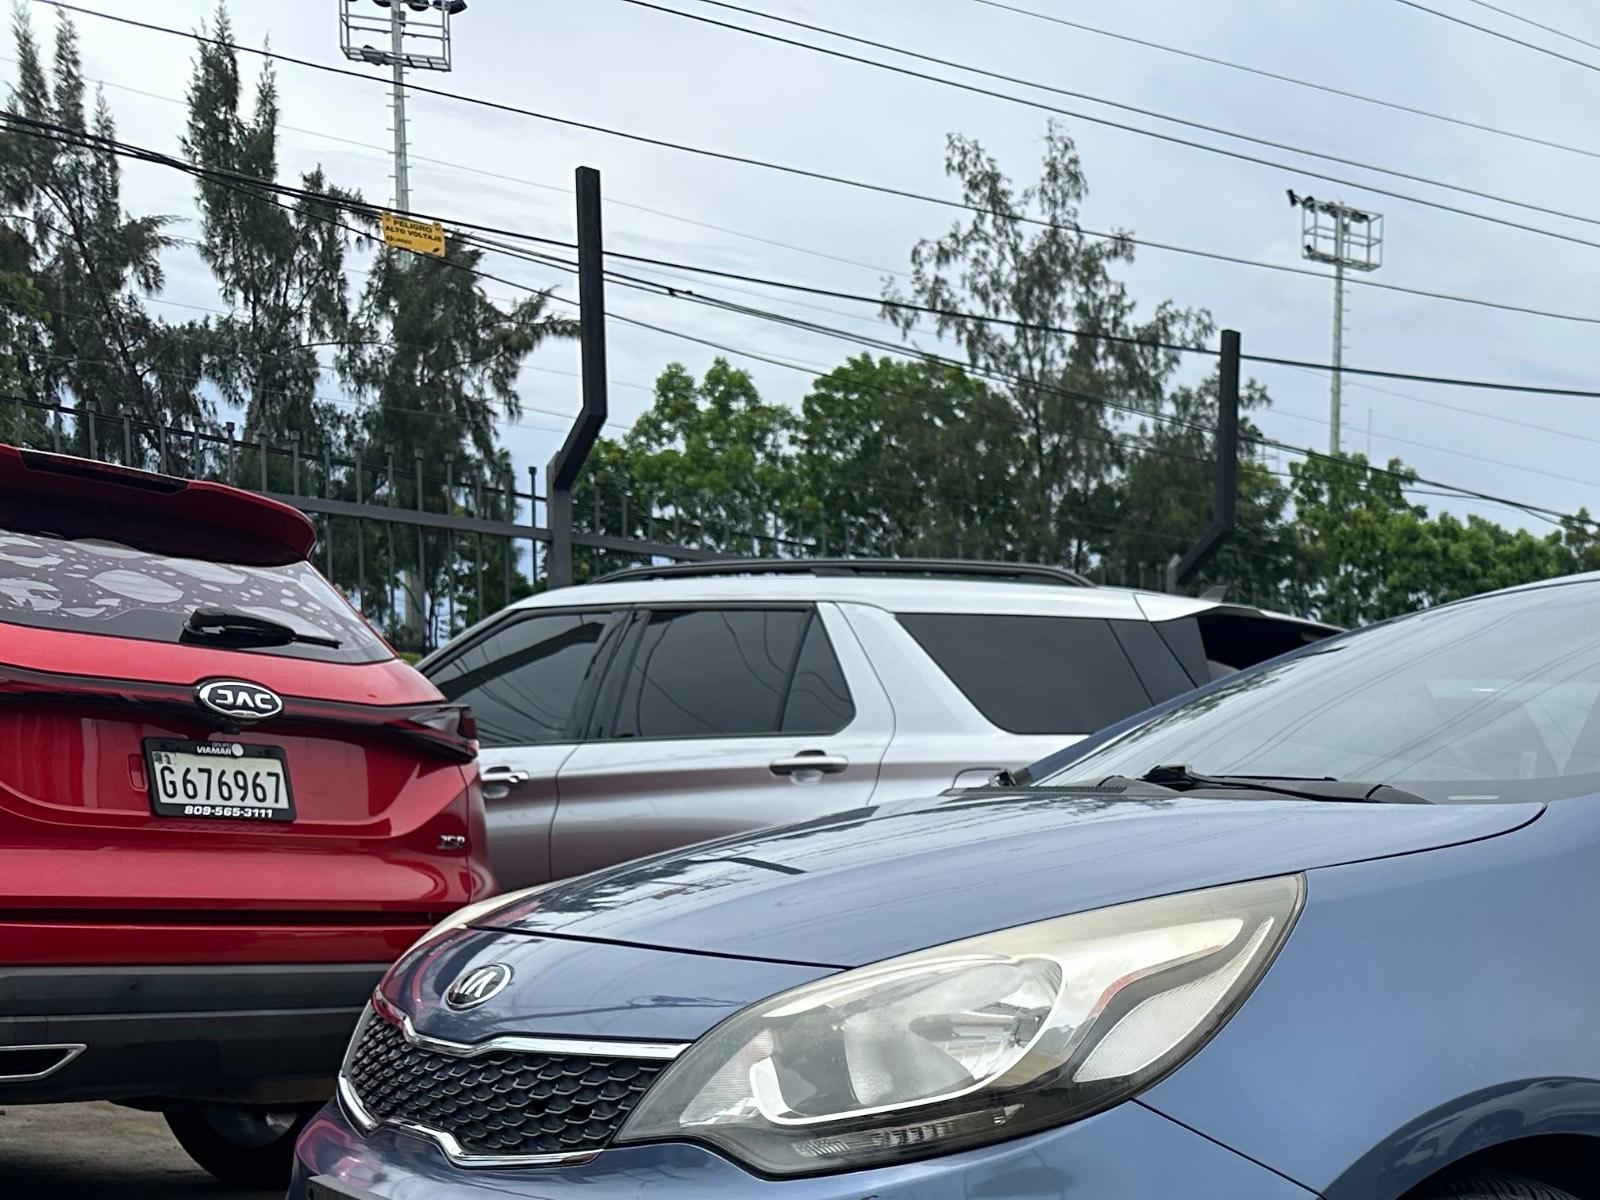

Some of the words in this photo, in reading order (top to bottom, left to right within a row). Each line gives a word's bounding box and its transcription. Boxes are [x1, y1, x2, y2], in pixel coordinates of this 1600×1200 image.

[385, 226, 406, 235] ALTO
[407, 230, 442, 242] VOLTAJE
[393, 220, 433, 233] PELIGRO
[215, 689, 273, 709] JAC
[196, 746, 232, 756] VIAMAR
[160, 765, 281, 804] G676967
